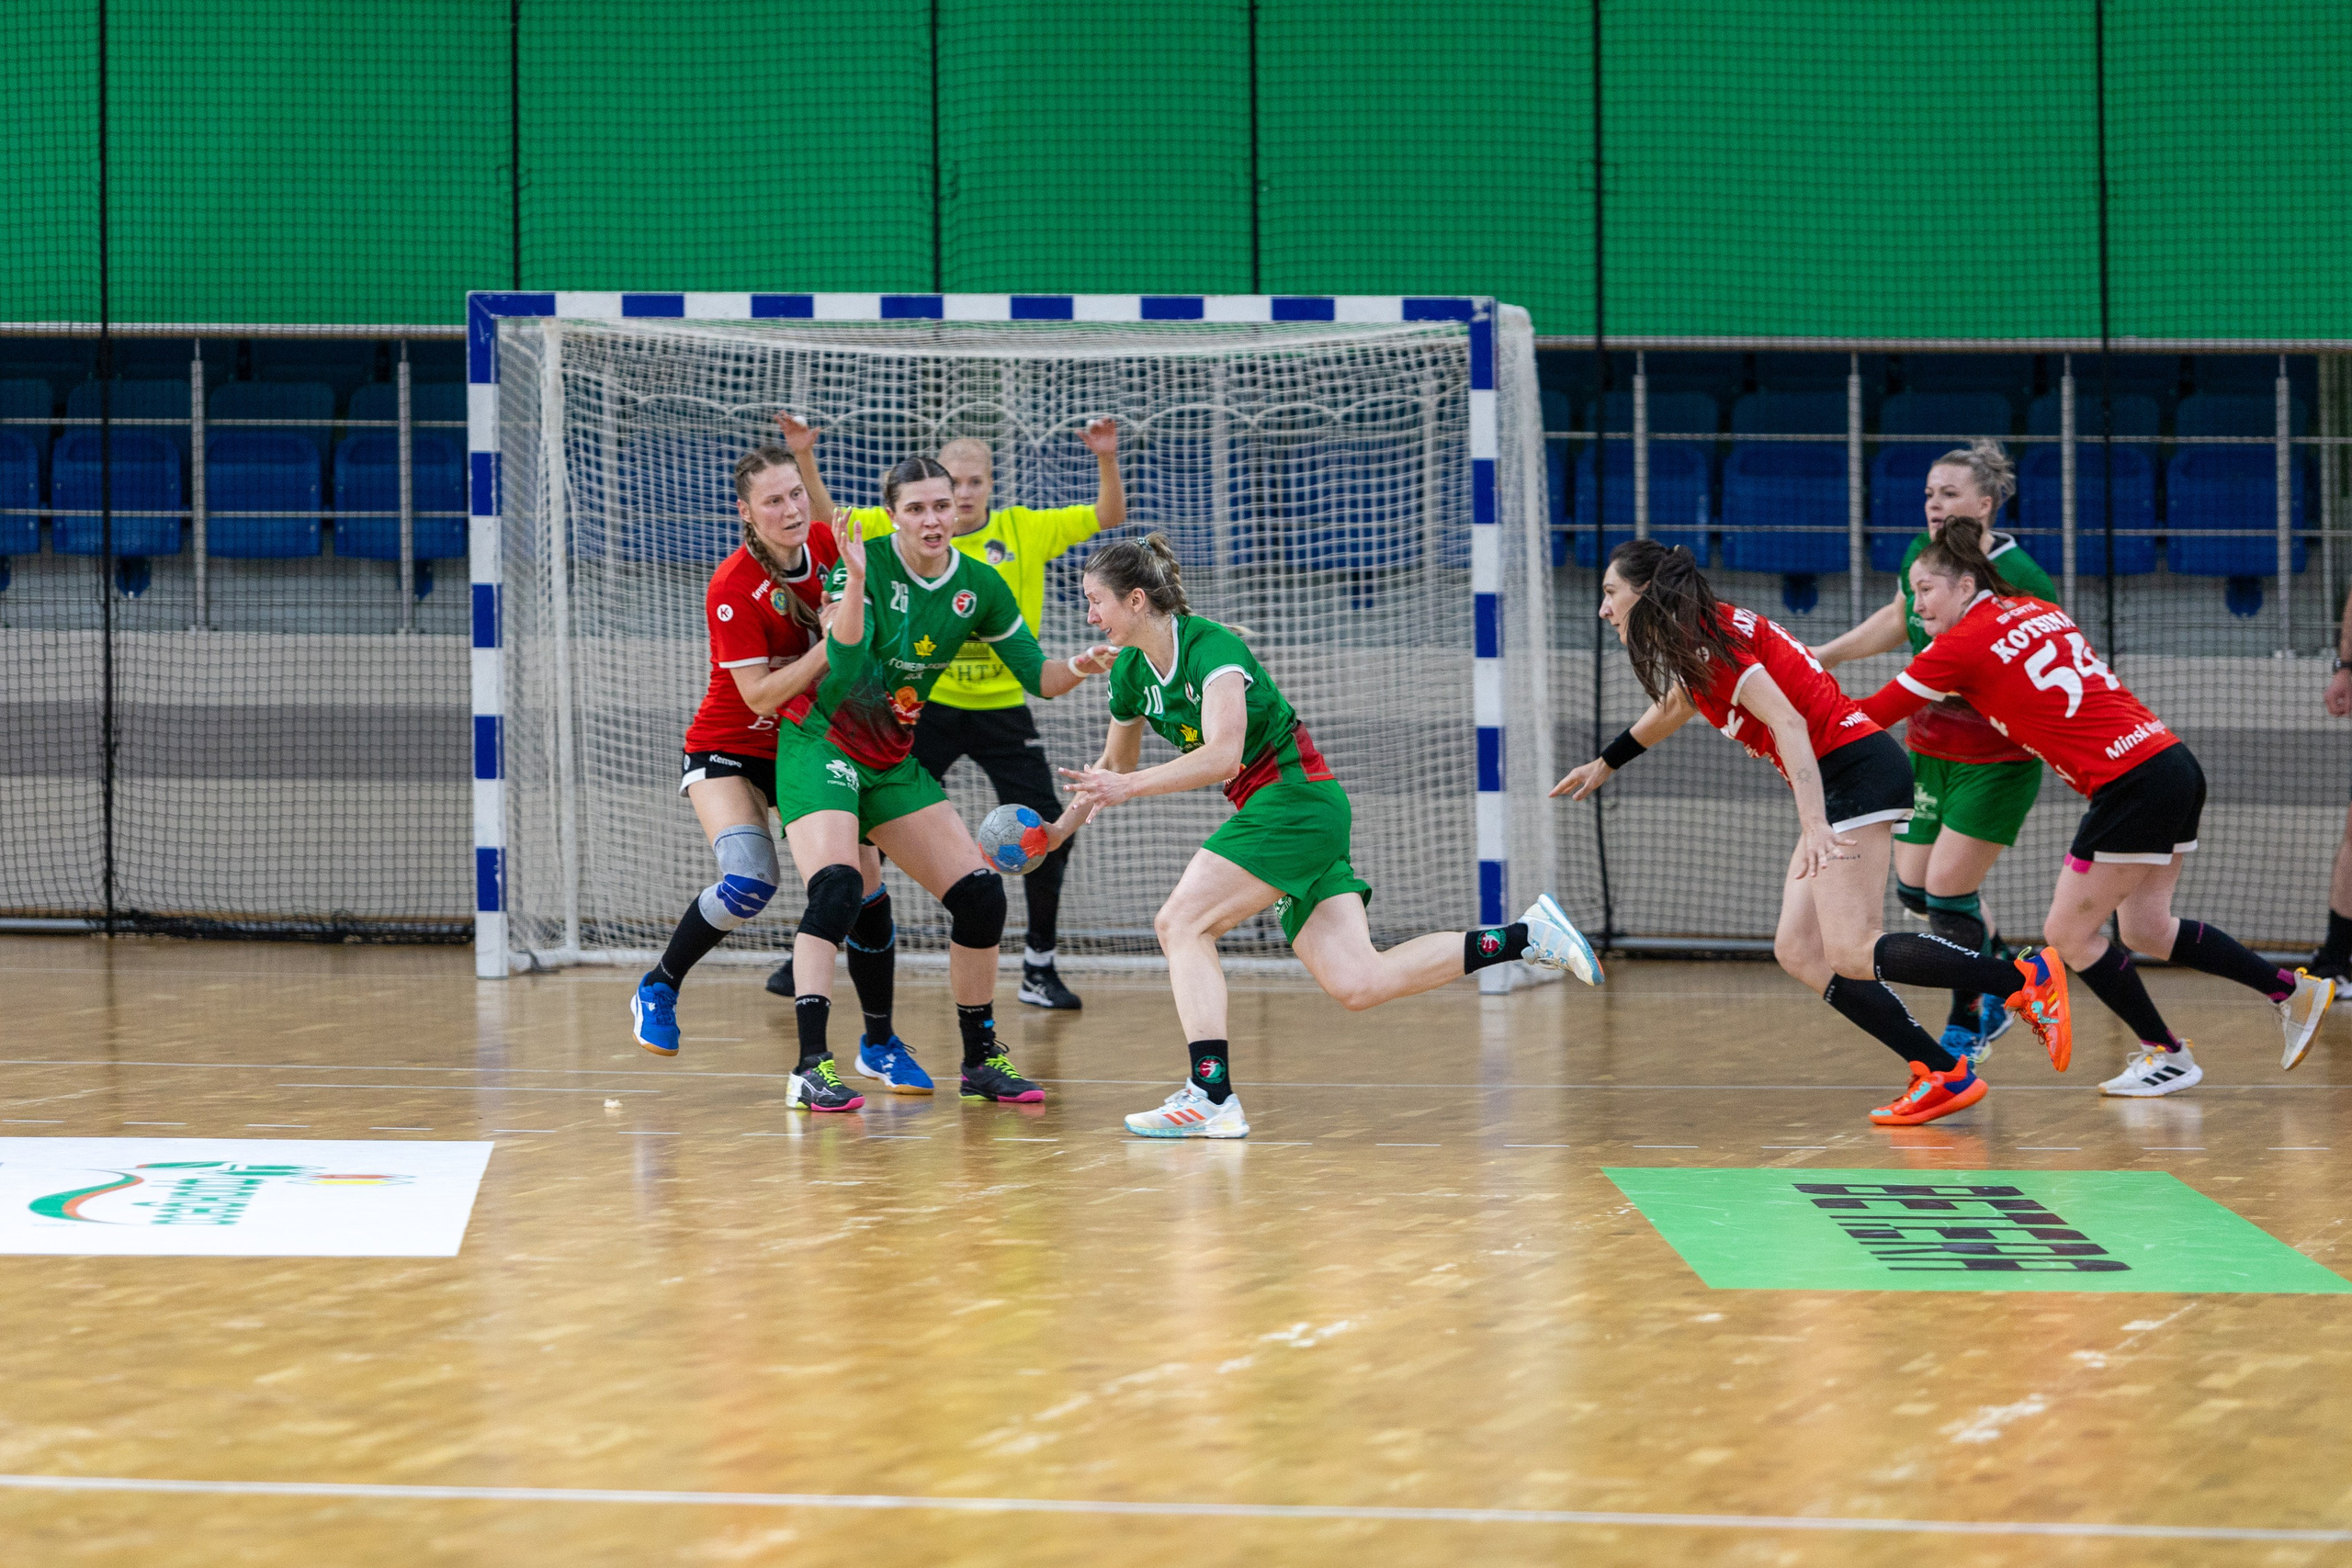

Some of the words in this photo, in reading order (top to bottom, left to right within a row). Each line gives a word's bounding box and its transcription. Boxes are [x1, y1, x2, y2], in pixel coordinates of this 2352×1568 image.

[890, 581, 909, 614] 26
[2024, 632, 2120, 718] 54
[1144, 684, 1164, 716] 10
[2105, 722, 2151, 761] Minsk
[709, 754, 742, 768] Kempa
[1792, 1183, 2132, 1271] BETERA
